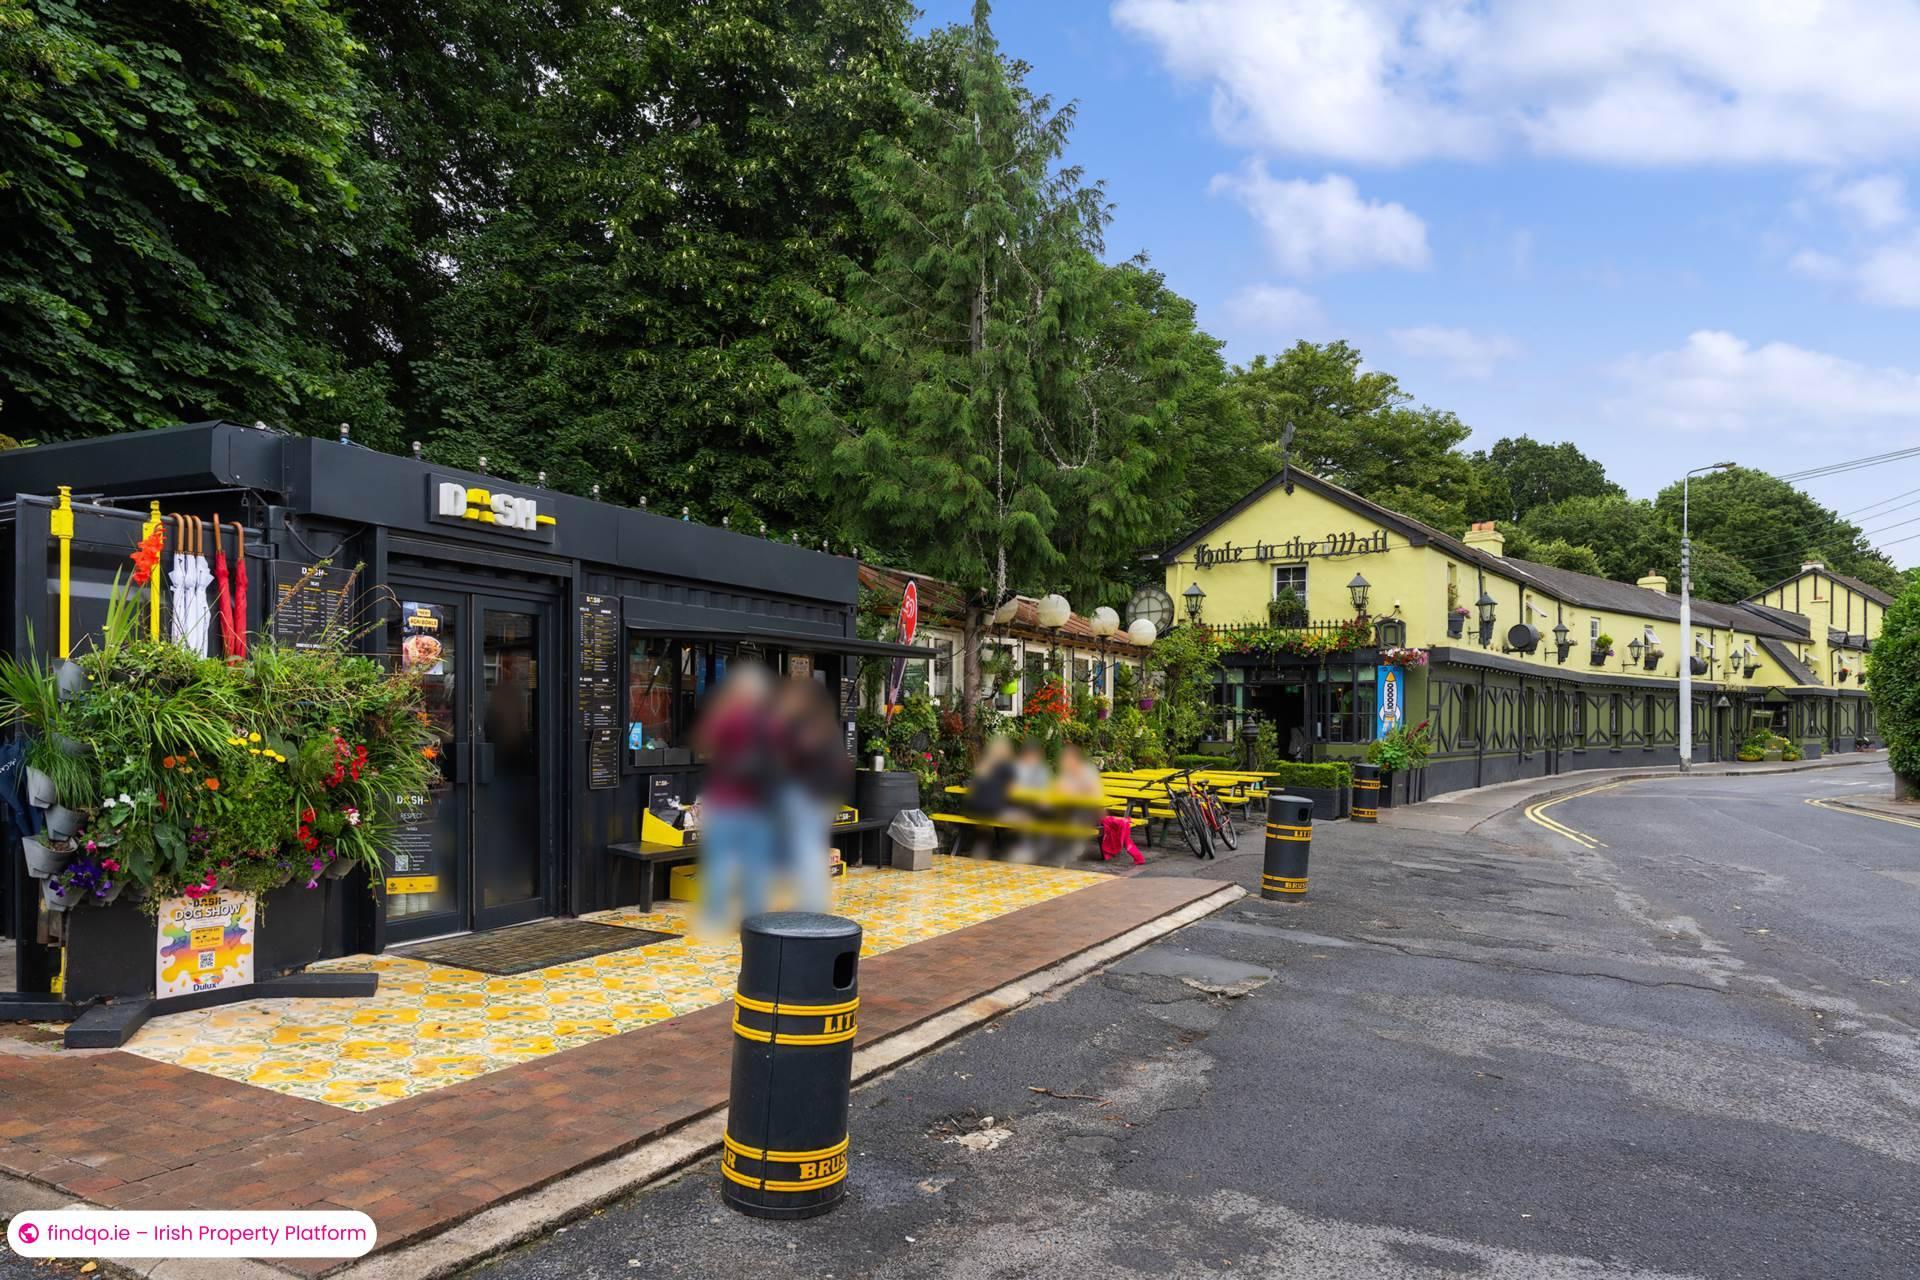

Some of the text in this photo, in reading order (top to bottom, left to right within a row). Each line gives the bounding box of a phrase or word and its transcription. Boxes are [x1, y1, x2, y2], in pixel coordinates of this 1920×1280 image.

[1194, 541, 1243, 570] Hole
[1285, 536, 1317, 563] the
[1327, 529, 1390, 557] Wall
[175, 903, 243, 921] DOG SHOW
[193, 982, 217, 992] Dulux
